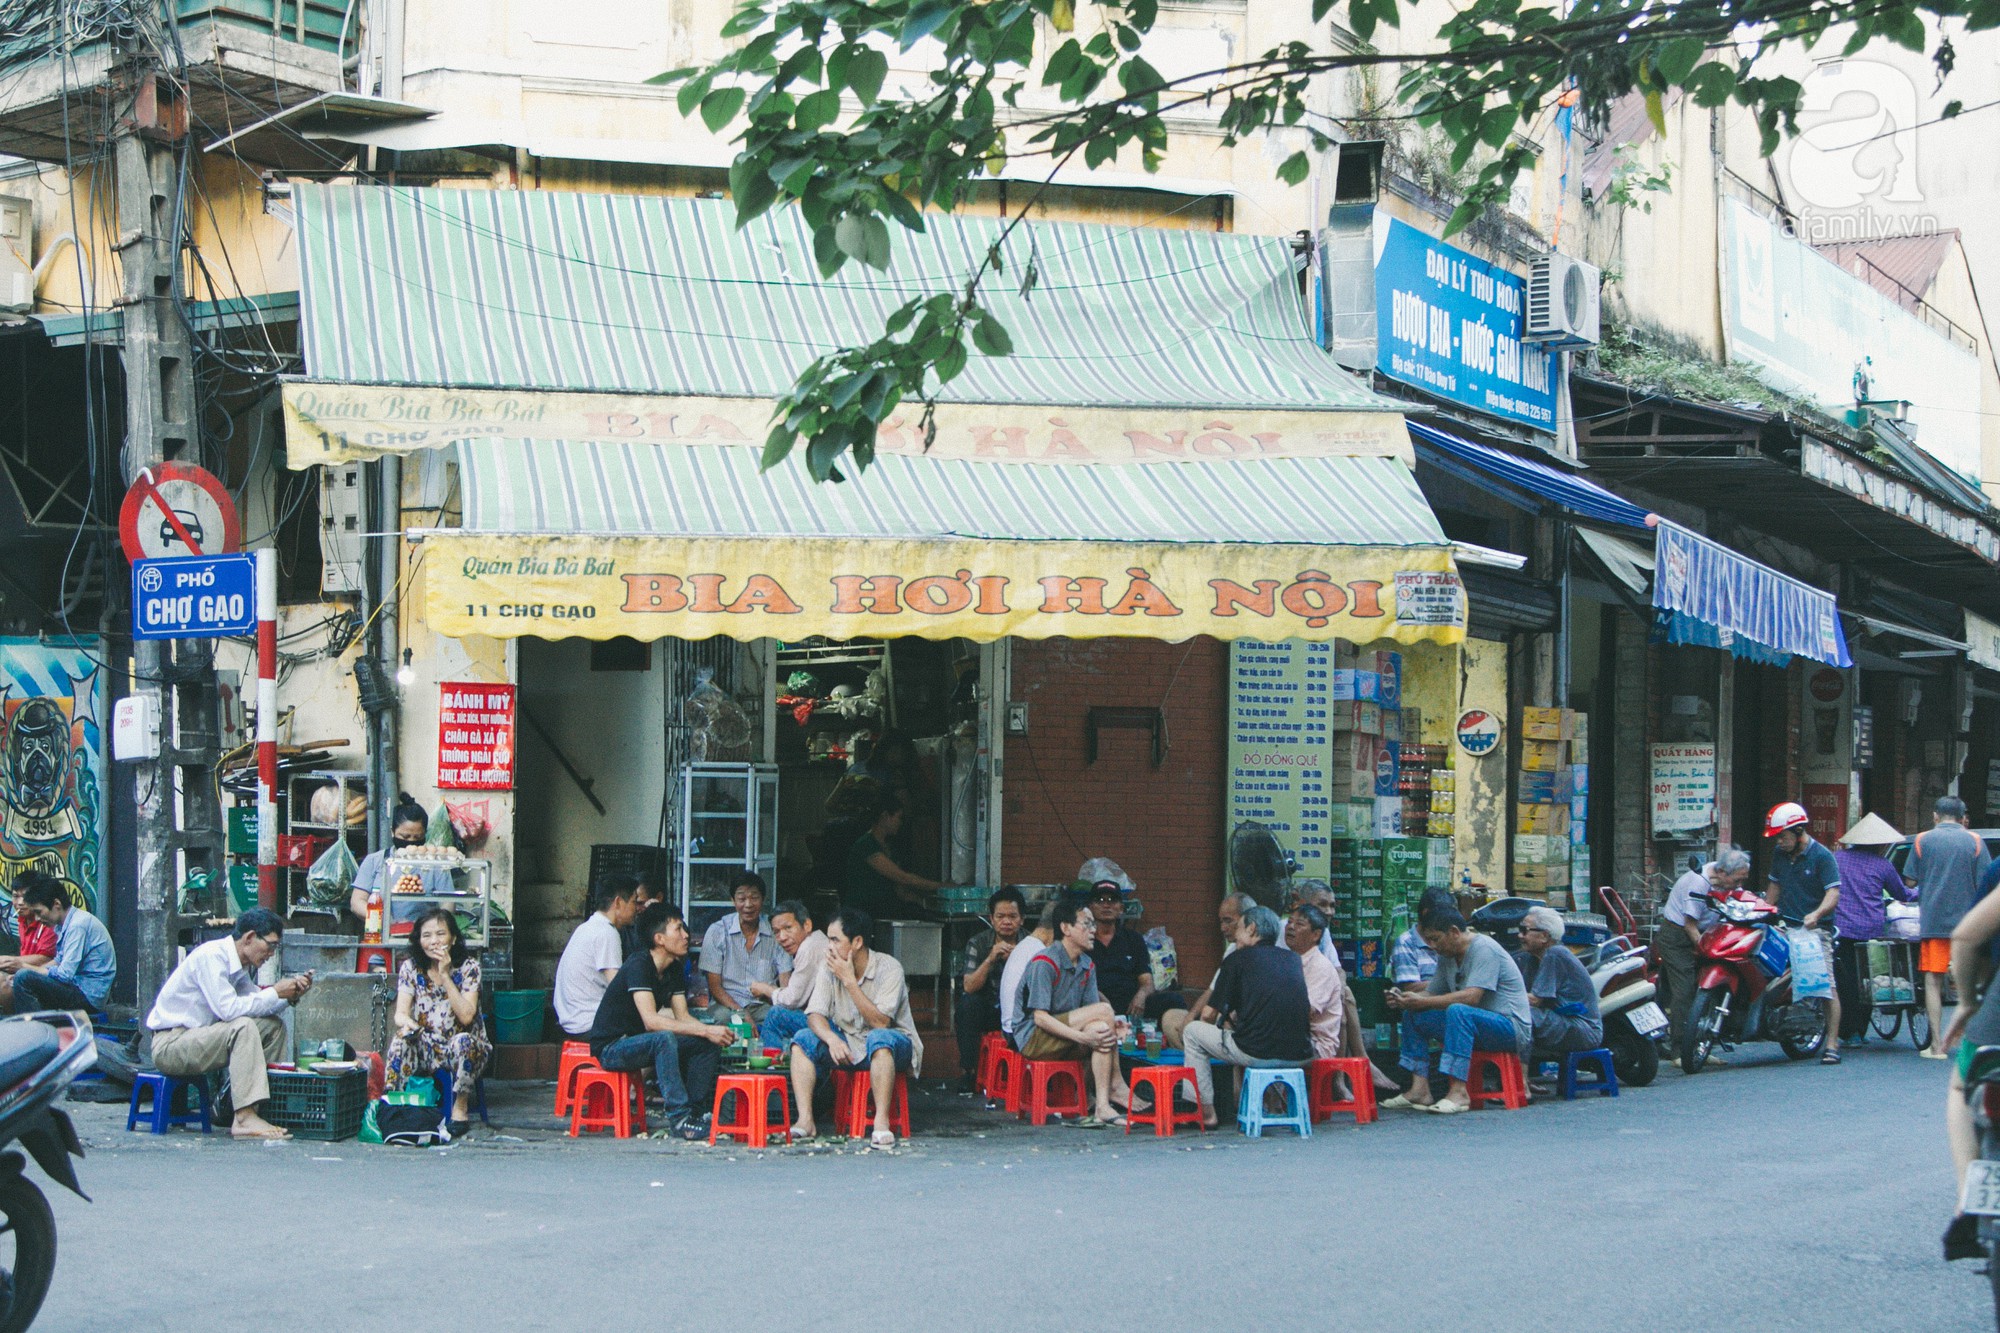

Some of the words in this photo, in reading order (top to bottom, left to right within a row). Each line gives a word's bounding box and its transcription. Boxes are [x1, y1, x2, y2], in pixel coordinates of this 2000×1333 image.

[1427, 248, 1449, 288] ĐẠI
[1452, 259, 1467, 292] LÝ
[1470, 269, 1494, 304] THU
[1393, 289, 1427, 356] RƯỢU
[1430, 305, 1451, 358] BIA
[1462, 313, 1494, 375] NƯỚC
[1496, 320, 1521, 384] GIẢI
[1416, 364, 1424, 379] 17
[296, 390, 367, 422] Quán
[377, 394, 431, 422] Bia
[442, 396, 483, 422] Bà
[494, 398, 546, 423] Bát
[1530, 406, 1541, 421] 225
[317, 431, 348, 451] 11
[582, 412, 752, 441] BIA
[968, 417, 1098, 460] HÀ
[176, 565, 216, 588] PHỐ
[462, 556, 513, 580] Quán
[517, 557, 549, 576] Bia
[554, 556, 579, 576] Bà
[584, 557, 616, 577] Bát
[620, 573, 803, 614] BIA
[830, 569, 1011, 614] HƠI
[1038, 567, 1183, 617] HÀ
[1208, 569, 1386, 628] NỘI
[146, 594, 194, 630] CHỢ
[199, 594, 244, 628] GẠO
[466, 604, 488, 618] 11
[499, 603, 545, 619] CHỢ
[551, 604, 597, 620] GẠO
[443, 690, 484, 709] BÁNH
[488, 692, 511, 711] MỲ
[445, 728, 468, 744] CHÂN
[470, 729, 481, 744] GÀ
[483, 727, 495, 744] XẢ
[441, 747, 470, 763] TRỨNG
[471, 747, 491, 764] NGẢI
[1654, 782, 1672, 797] BỘT
[23, 819, 58, 836] 1991
[1391, 850, 1423, 860] TUBORG
